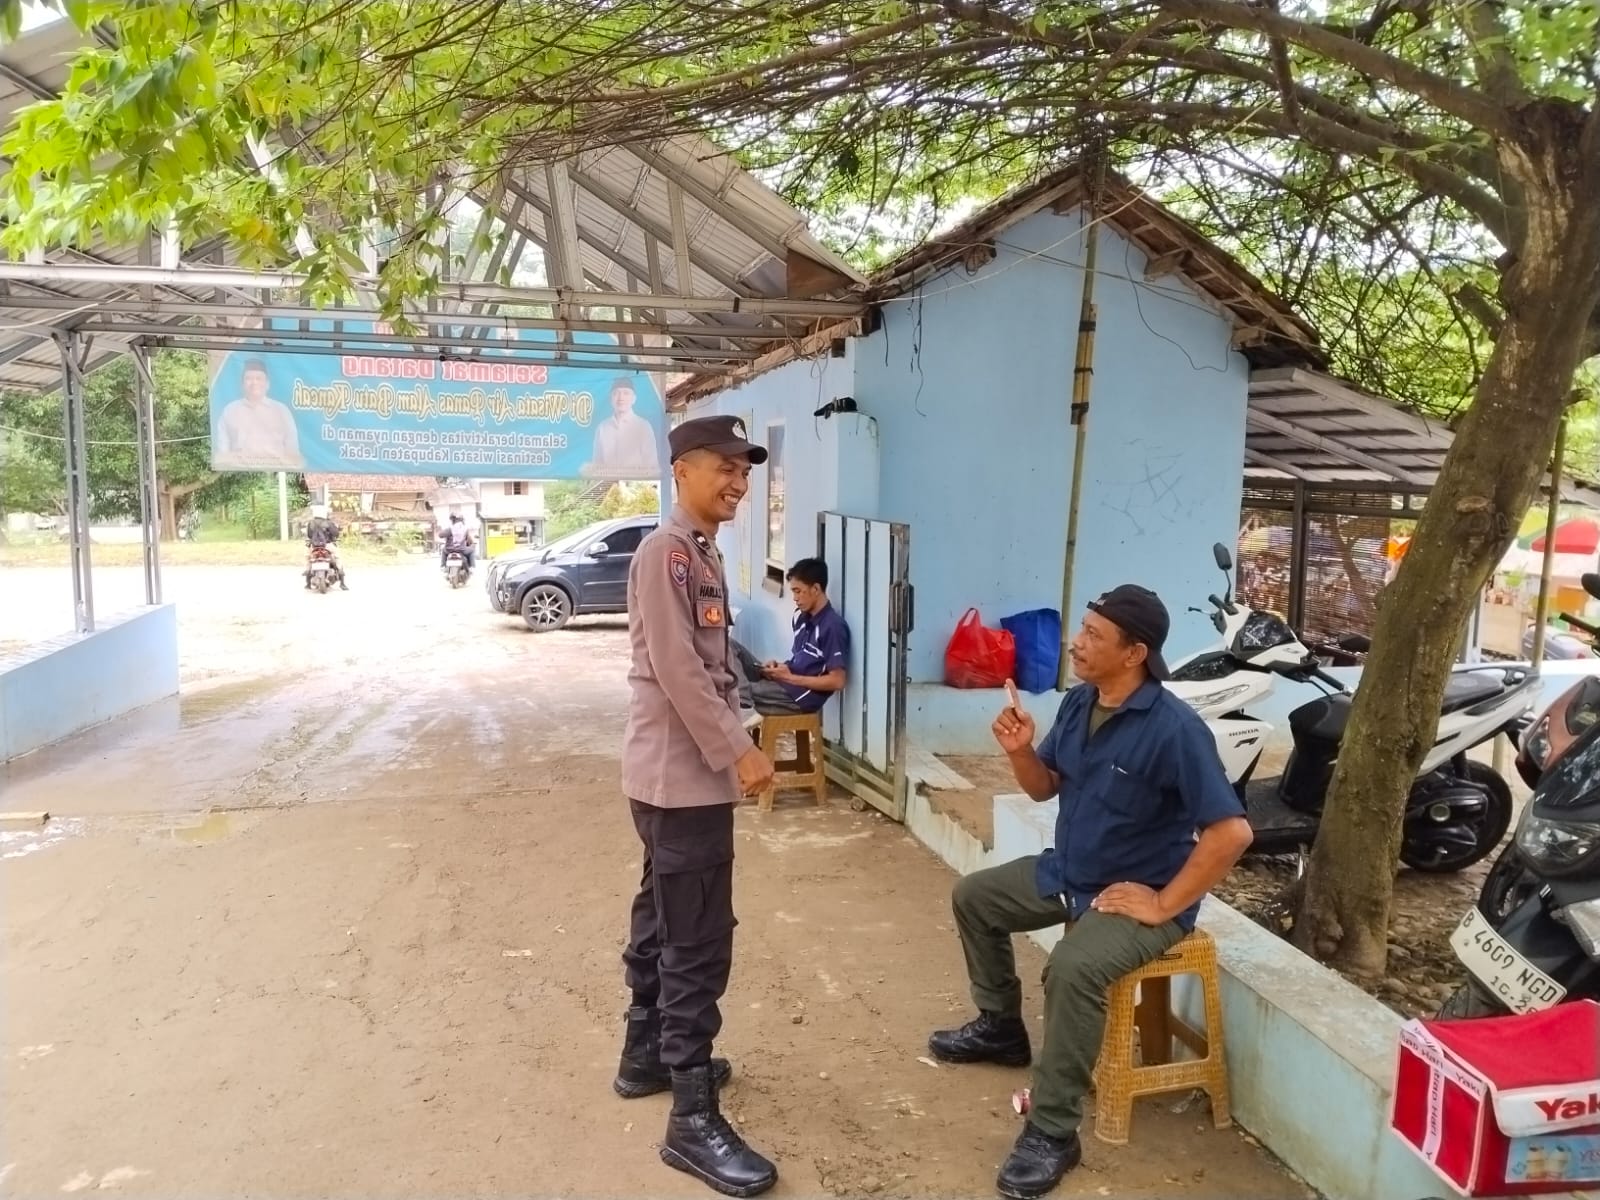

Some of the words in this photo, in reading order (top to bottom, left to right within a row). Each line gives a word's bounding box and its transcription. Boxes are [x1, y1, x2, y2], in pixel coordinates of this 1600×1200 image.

[1228, 728, 1260, 737] HONDA
[1463, 911, 1475, 929] B
[1516, 967, 1558, 1003] NGD
